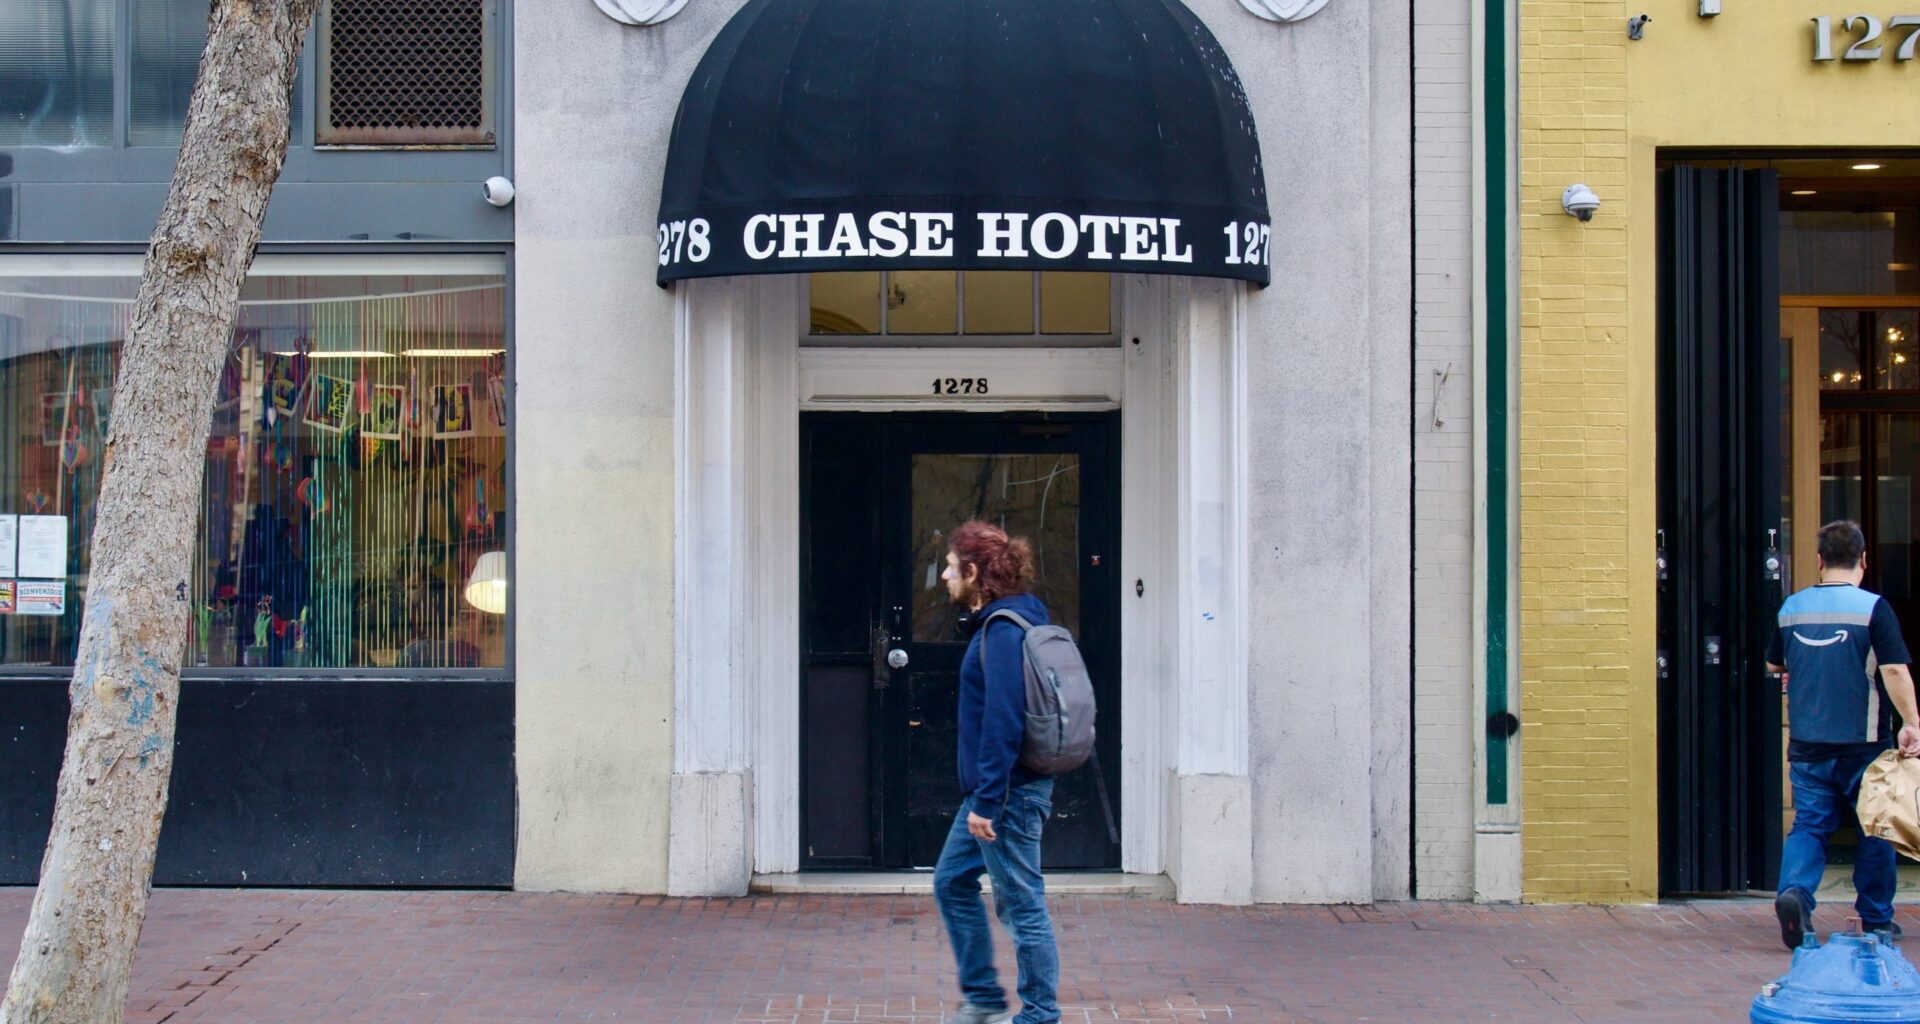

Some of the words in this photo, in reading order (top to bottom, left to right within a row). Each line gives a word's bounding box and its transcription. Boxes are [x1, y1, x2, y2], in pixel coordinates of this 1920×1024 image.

[1808, 15, 1920, 61] 127
[743, 211, 953, 260] CHASE
[977, 212, 1193, 263] HOTEL
[932, 377, 989, 395] 1278
